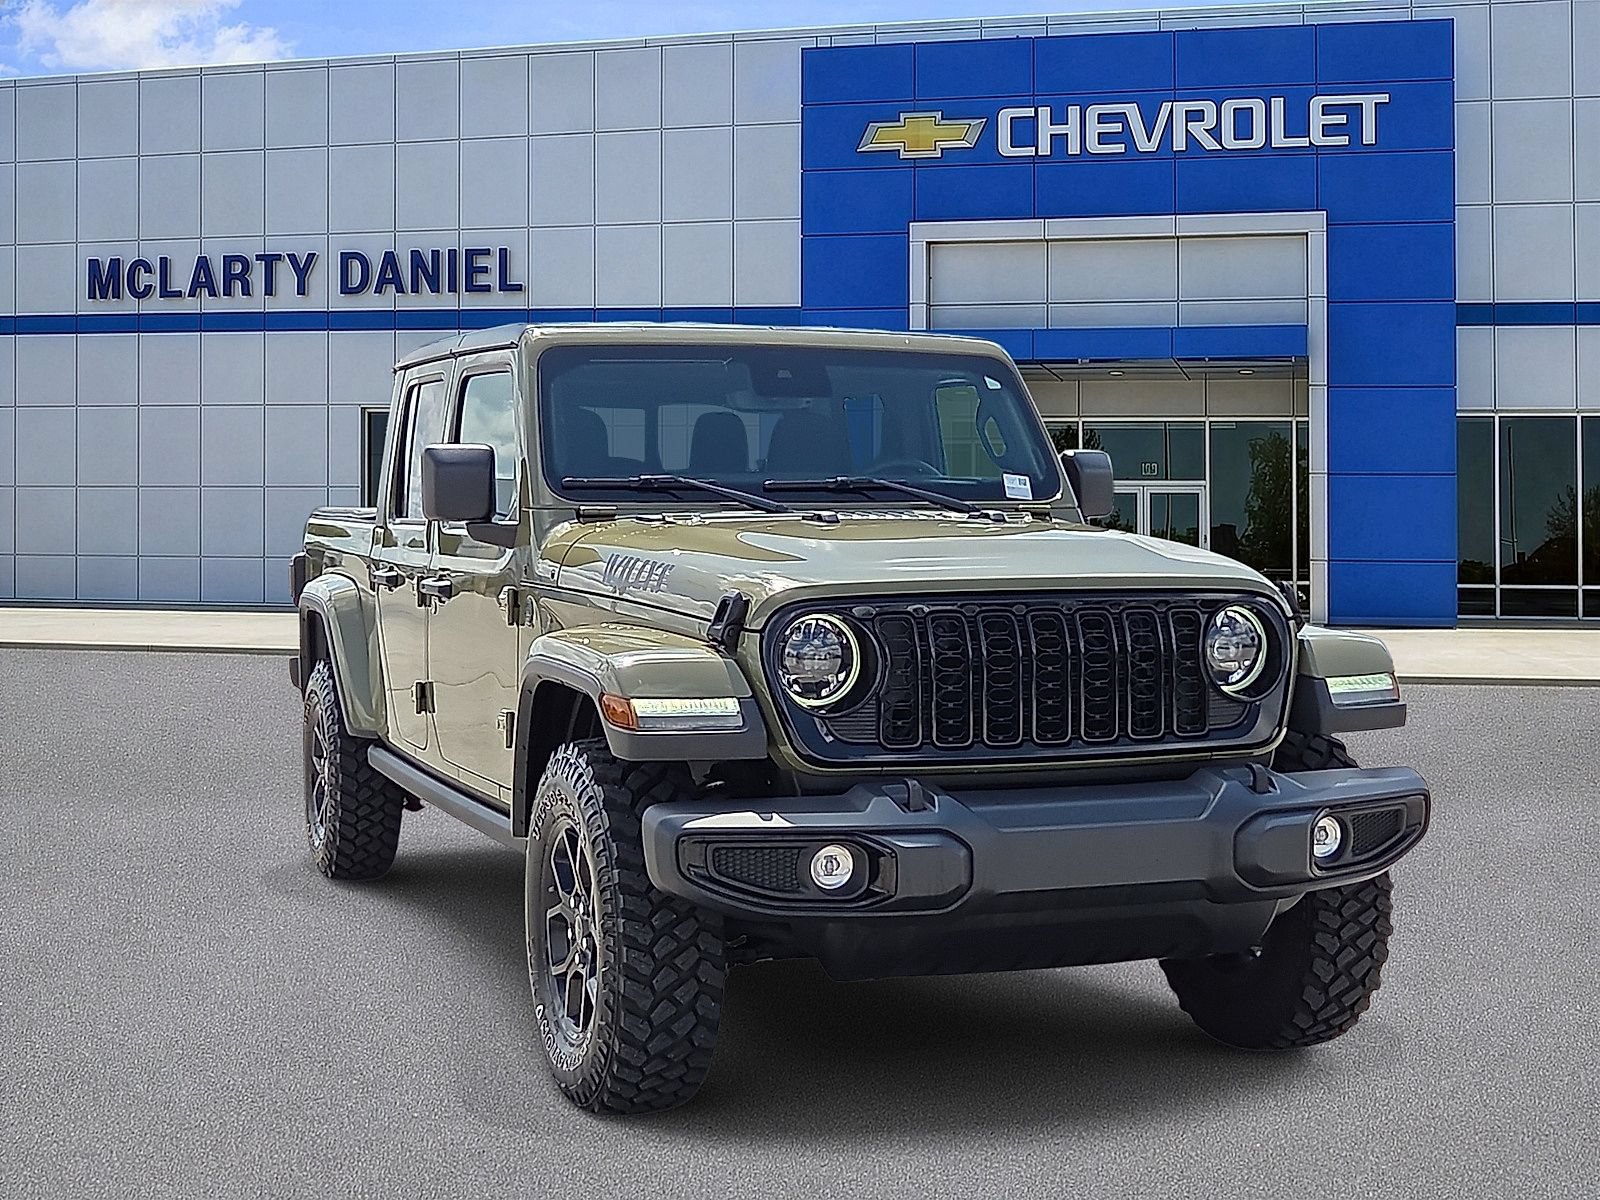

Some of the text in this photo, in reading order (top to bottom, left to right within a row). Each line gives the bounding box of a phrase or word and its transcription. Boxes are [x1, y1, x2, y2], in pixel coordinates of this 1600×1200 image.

[998, 94, 1390, 157] CHEVROLET
[87, 246, 525, 300] MCLARTY DANIEL
